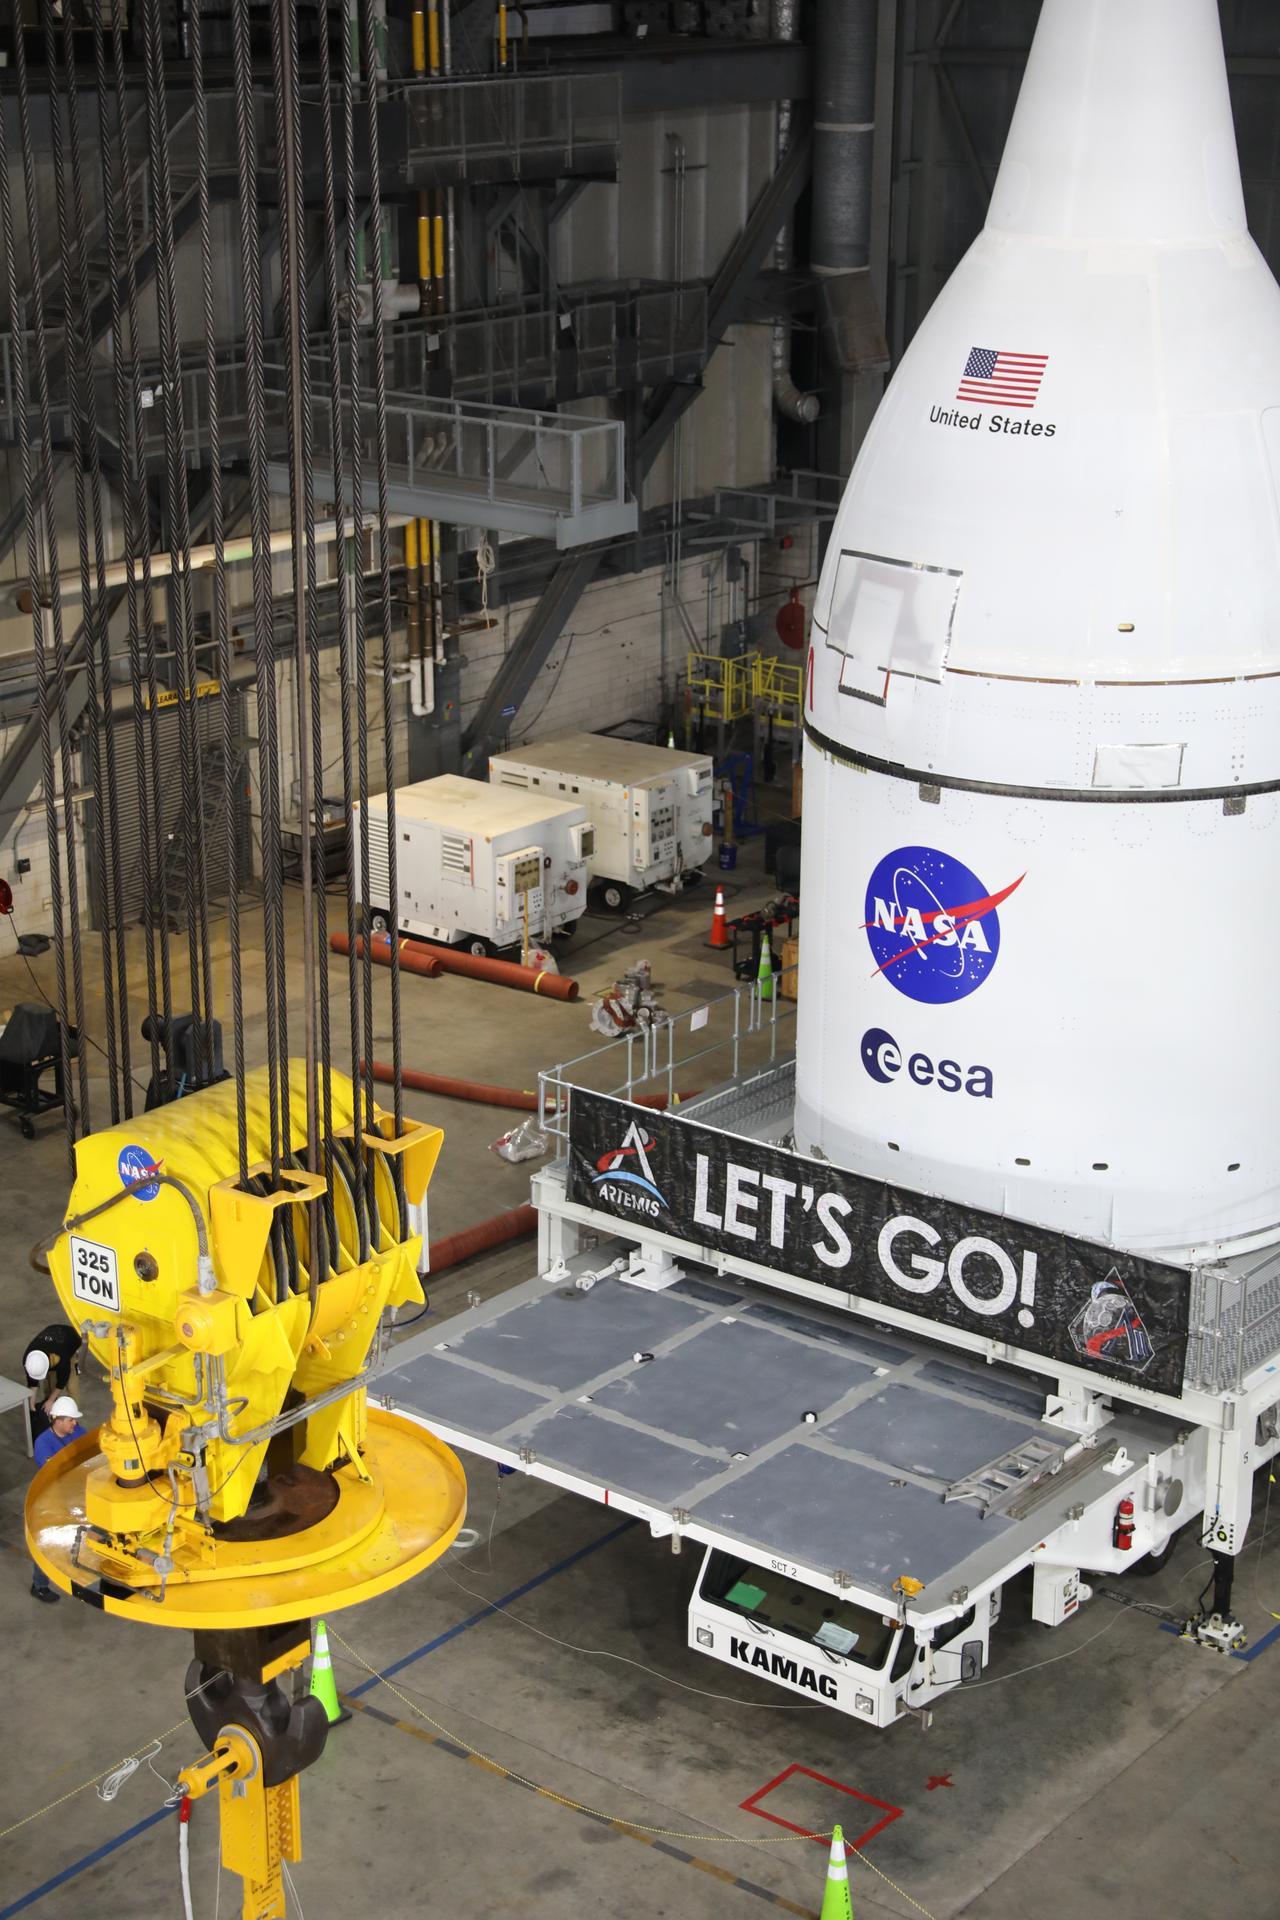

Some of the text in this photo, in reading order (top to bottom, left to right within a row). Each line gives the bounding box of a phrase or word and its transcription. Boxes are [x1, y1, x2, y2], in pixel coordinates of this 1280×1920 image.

[930, 405, 1056, 437] United States
[873, 896, 992, 953] NASA
[908, 1052, 993, 1099] esa
[599, 1184, 660, 1217] ARTEMIS
[693, 1152, 1038, 1328] LET'S GO!
[78, 1247, 110, 1273] 325
[78, 1271, 113, 1300] TON
[771, 1559, 798, 1578] SCT 2
[731, 1636, 838, 1701] KAMAG
